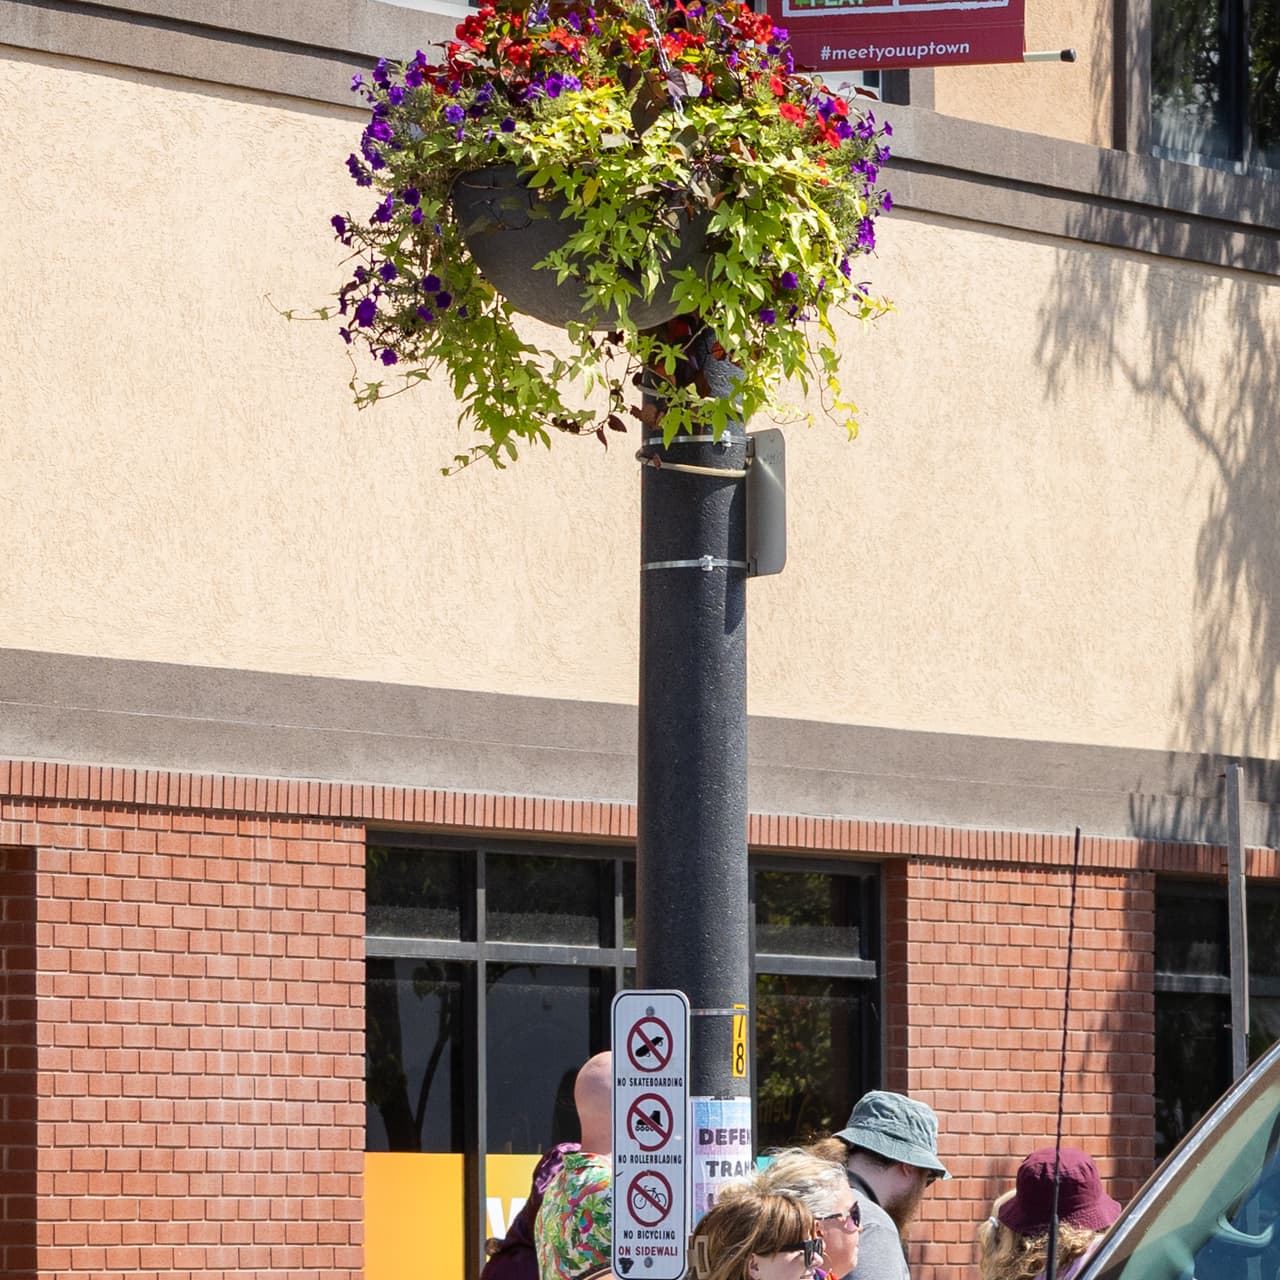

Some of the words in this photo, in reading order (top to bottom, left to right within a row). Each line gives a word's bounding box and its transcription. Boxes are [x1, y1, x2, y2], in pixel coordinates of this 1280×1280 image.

[820, 41, 970, 61] #meetyouuptown
[617, 1077, 627, 1087] NO
[629, 1077, 683, 1087] SKATEBOARDING
[618, 1154, 627, 1164] NO
[630, 1154, 682, 1165] ROLLERBLADING
[623, 1230, 634, 1240] NO
[637, 1230, 676, 1240] BICYCLING
[618, 1246, 631, 1256] ON
